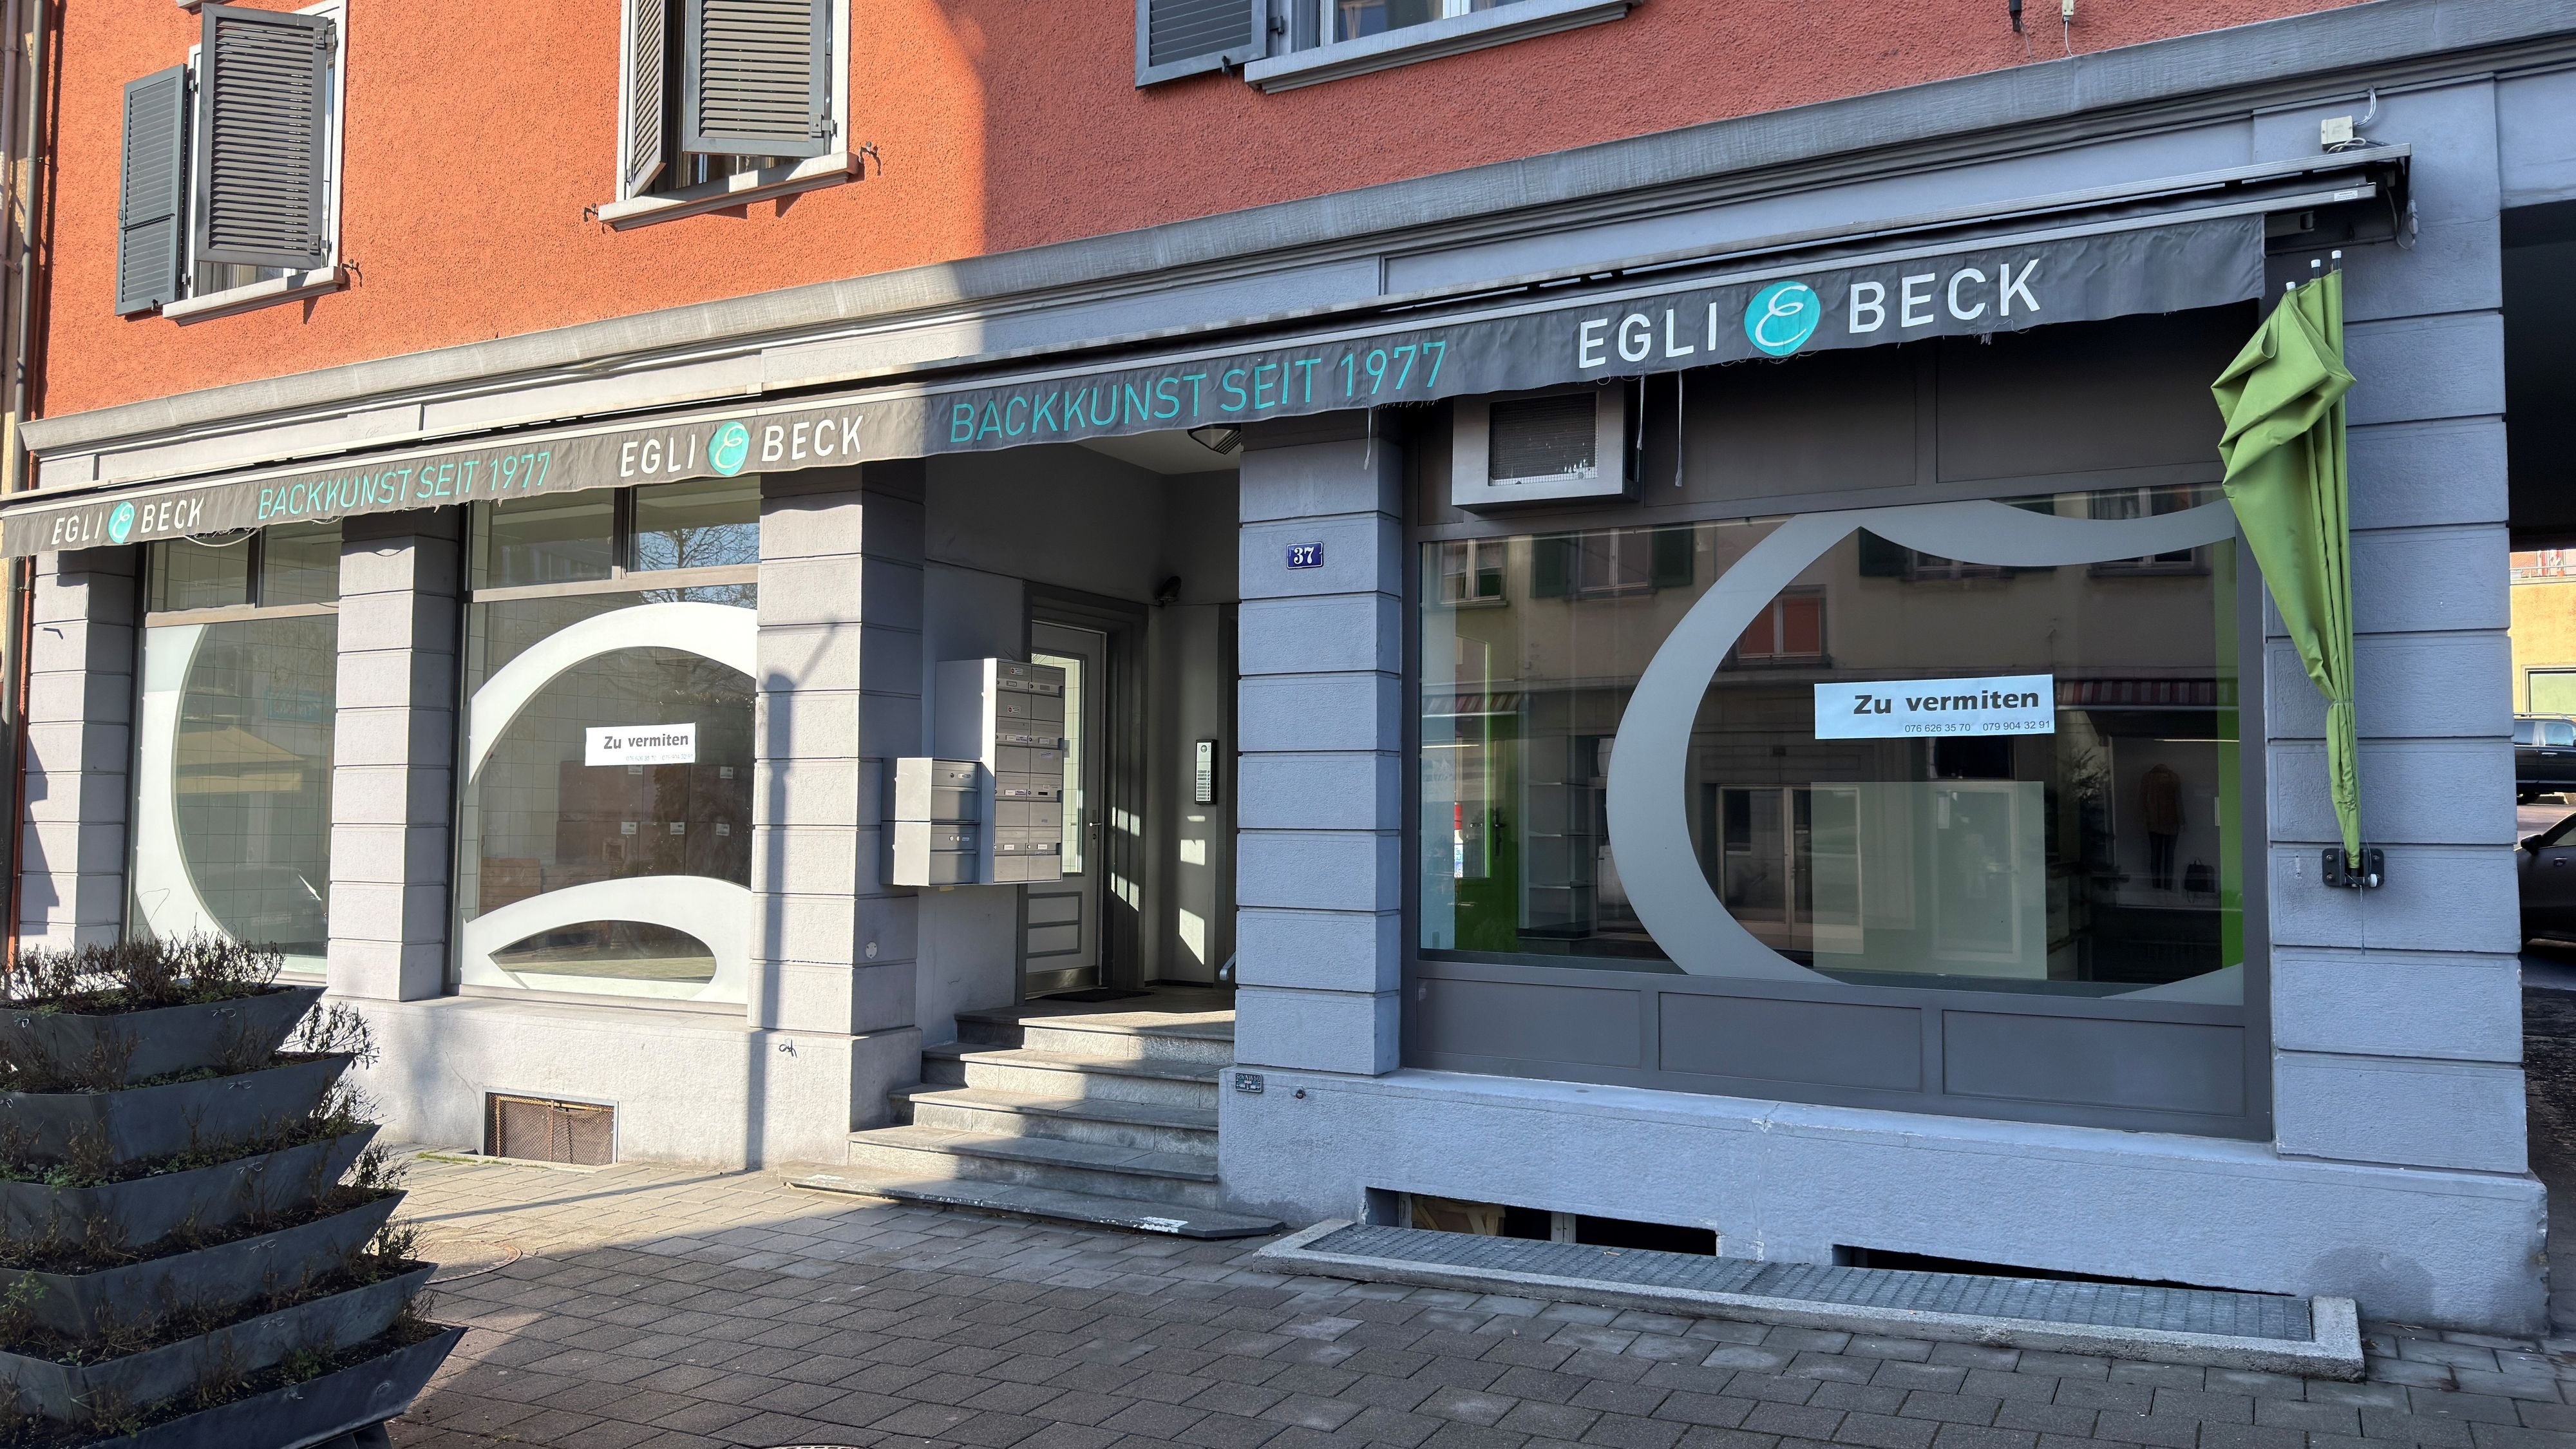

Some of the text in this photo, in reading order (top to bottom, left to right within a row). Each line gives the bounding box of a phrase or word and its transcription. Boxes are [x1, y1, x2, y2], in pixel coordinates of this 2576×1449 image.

[1578, 301, 1717, 368] EGLI
[1849, 258, 2041, 334] BECK
[950, 339, 1447, 444] BACKKUNST SEIT 1977
[620, 433, 696, 477] EGLI
[761, 415, 864, 462] BECK
[259, 451, 551, 520] BACKKUNST SEIT 1977
[50, 511, 103, 545] EGLI
[140, 497, 205, 533] BECK
[1294, 546, 1314, 564] 37
[1853, 690, 2039, 714] Zu vermiten
[603, 734, 688, 750] Zu vermiten
[1904, 720, 2050, 733] 076 626 35 70 079 904 32 91
